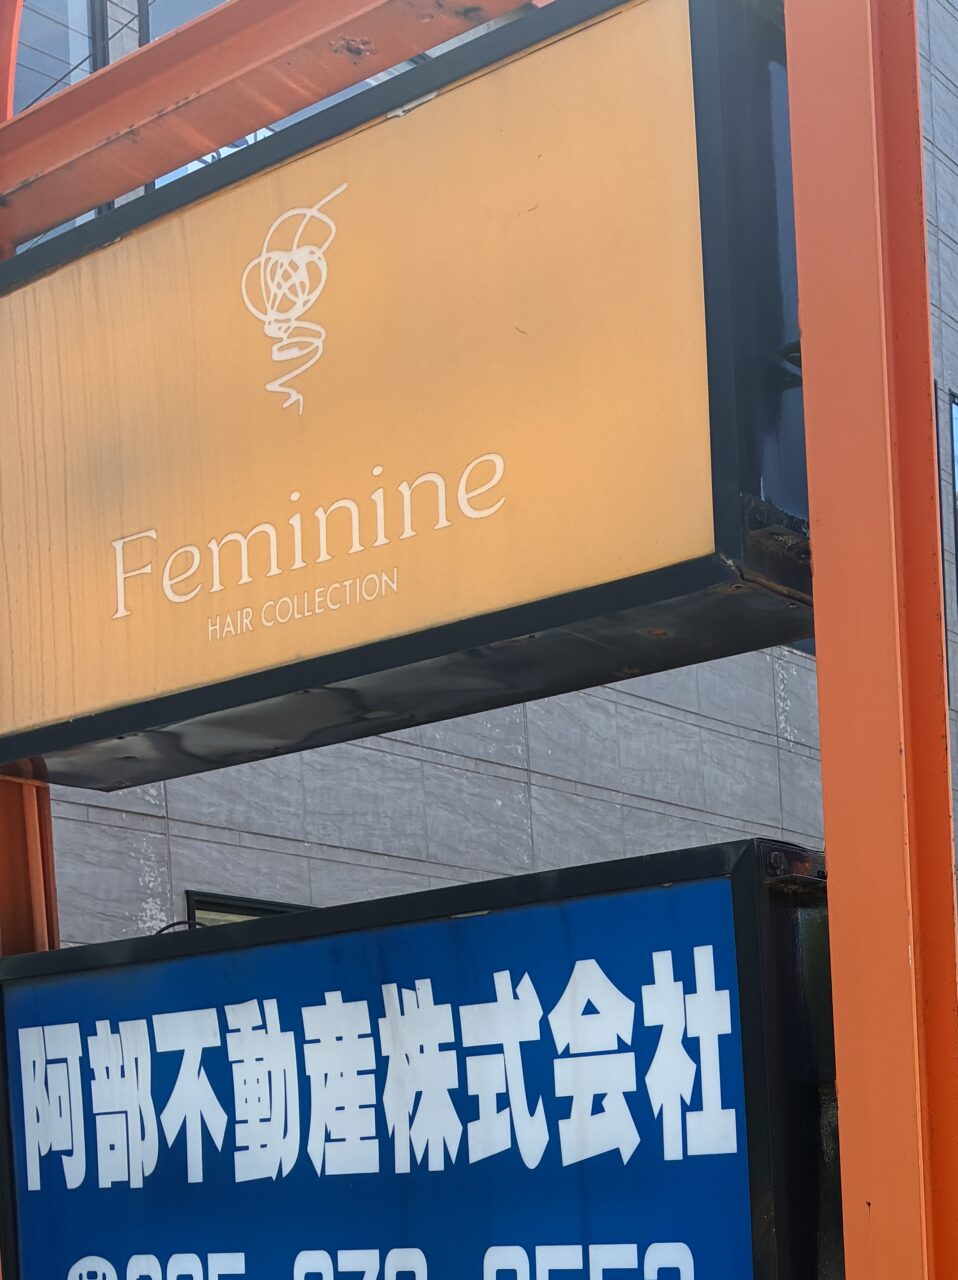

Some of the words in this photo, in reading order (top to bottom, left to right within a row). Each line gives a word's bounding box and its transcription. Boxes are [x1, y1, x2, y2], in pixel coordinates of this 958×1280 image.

[110, 452, 506, 620] Feminine
[208, 606, 254, 642] HAIR
[261, 566, 399, 627] COLLECTION
[17, 944, 738, 1191] 阿部不動産株式会社
